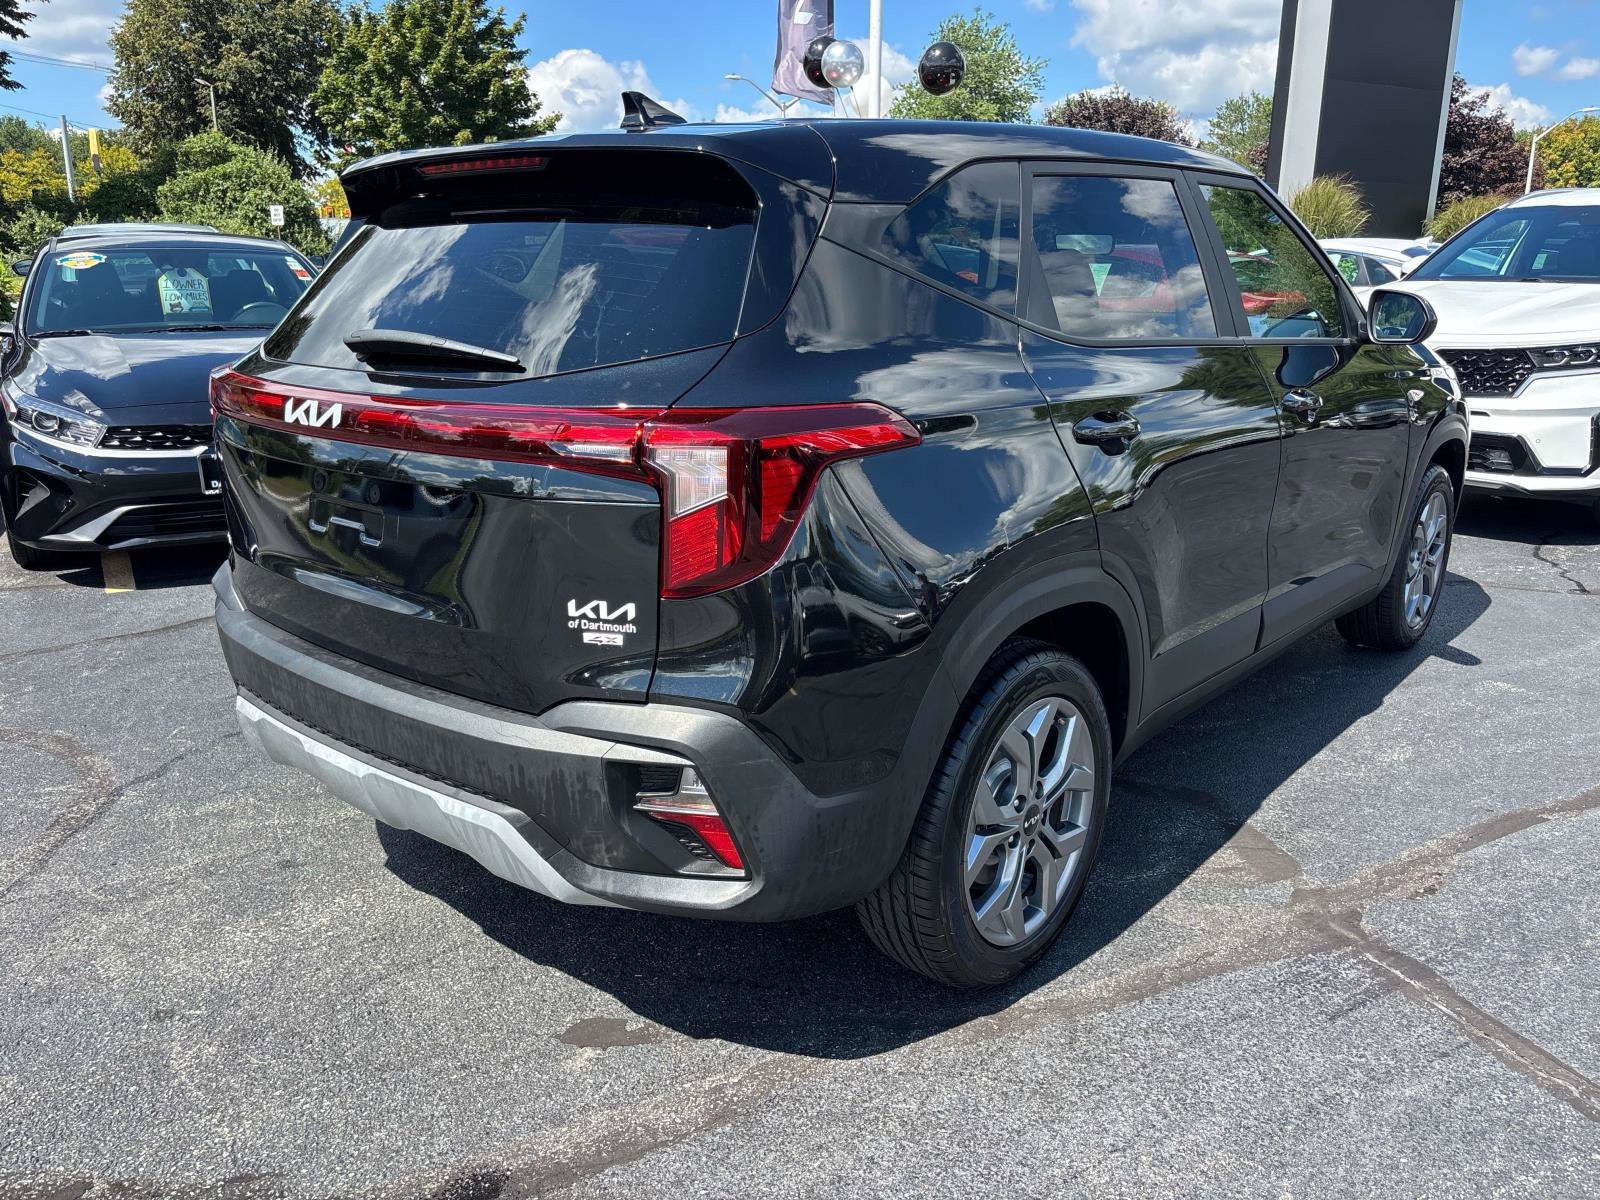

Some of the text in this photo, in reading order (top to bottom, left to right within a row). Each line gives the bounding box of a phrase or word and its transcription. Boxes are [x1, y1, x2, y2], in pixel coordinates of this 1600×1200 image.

[172, 280, 205, 289] OWNER
[165, 292, 208, 302] LOW MILES
[284, 397, 343, 429] KIA
[567, 599, 636, 621] KIA
[568, 619, 637, 633] of Dartmouth
